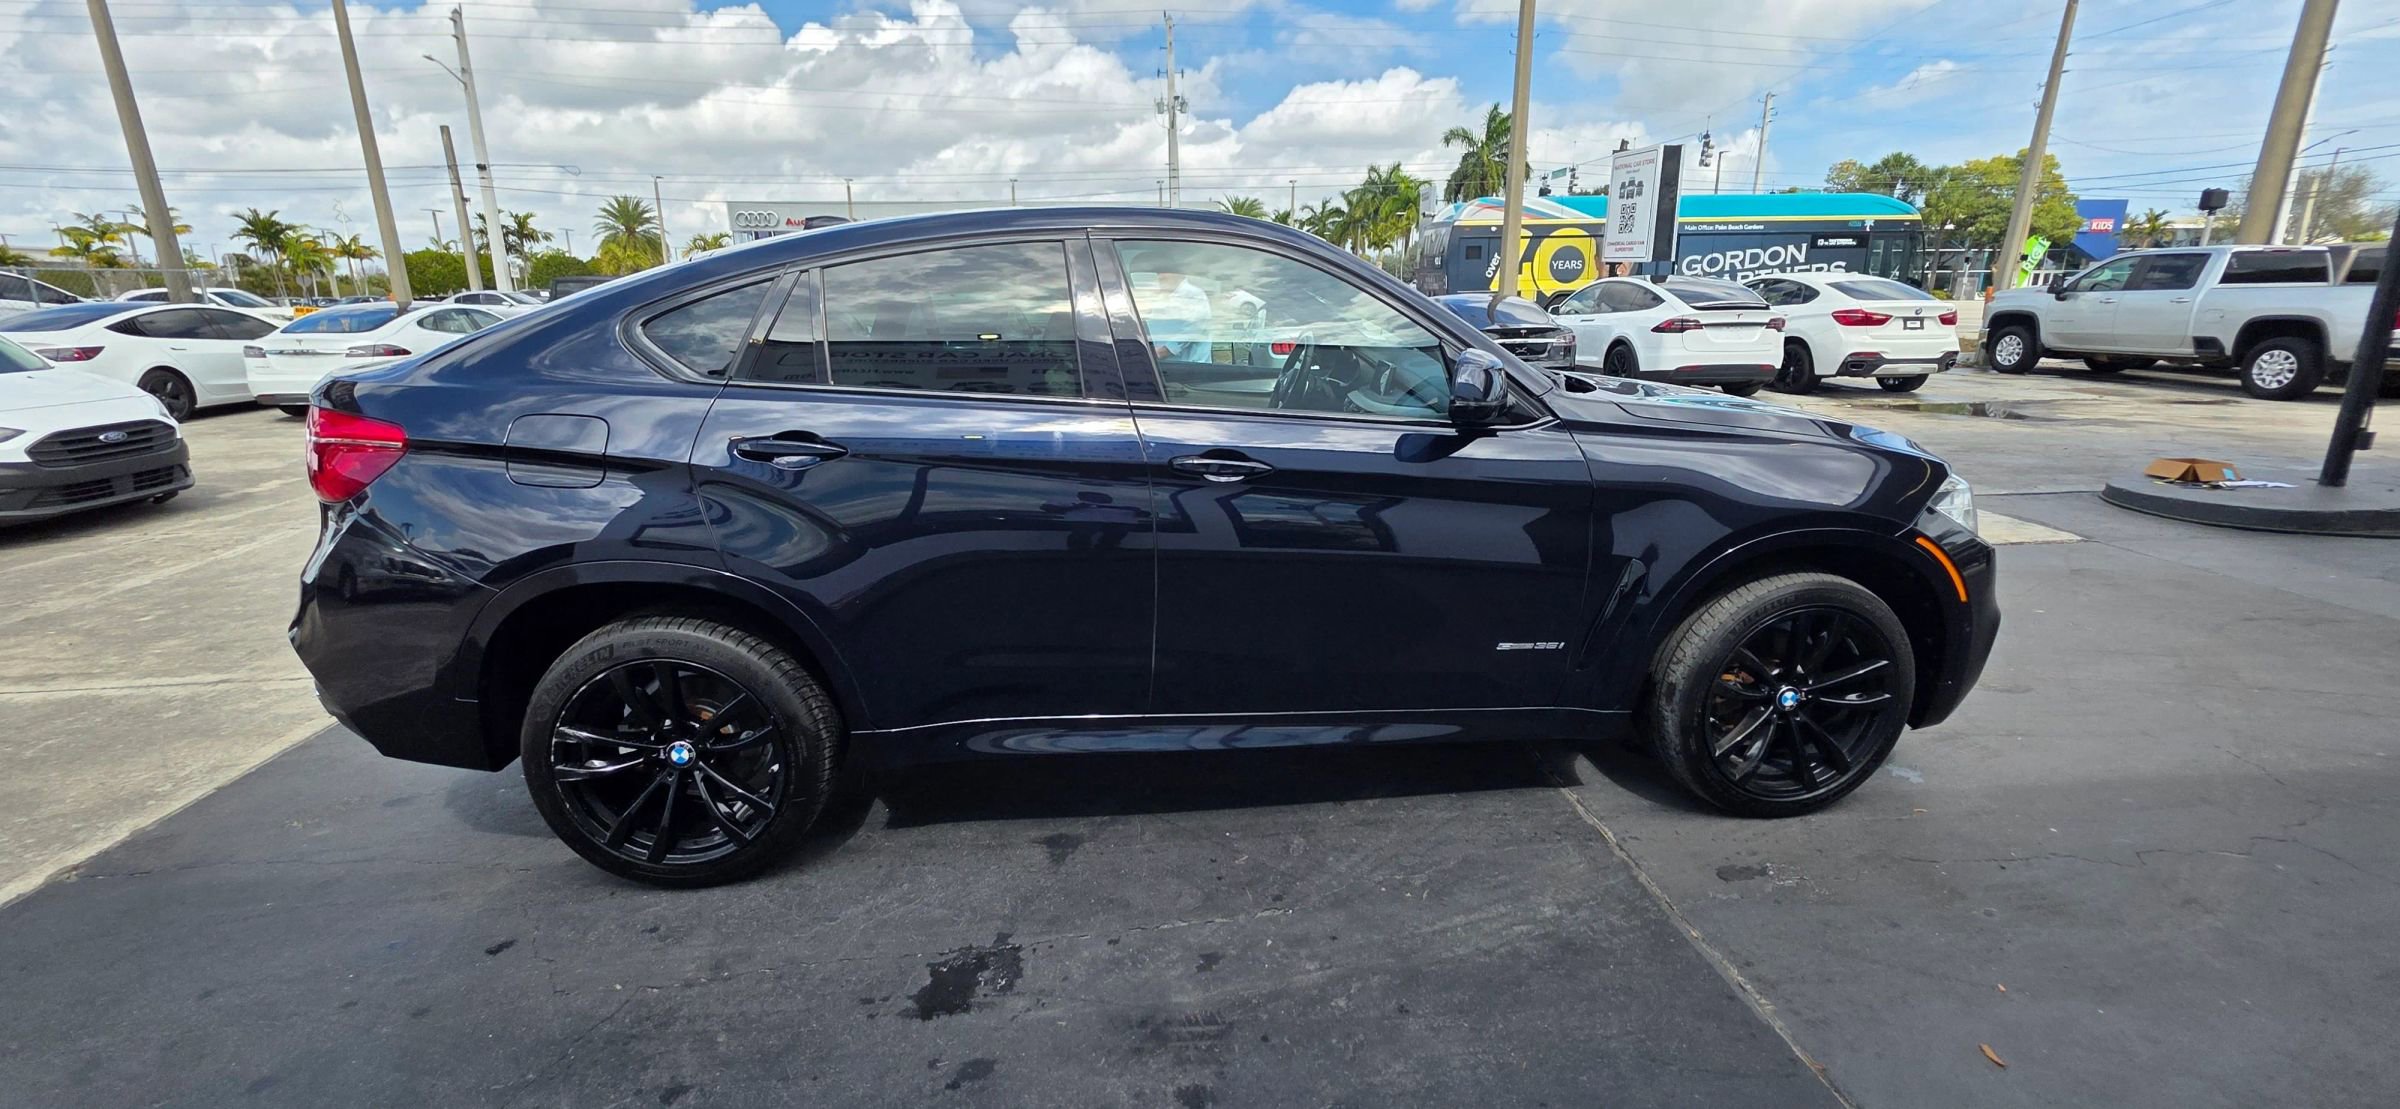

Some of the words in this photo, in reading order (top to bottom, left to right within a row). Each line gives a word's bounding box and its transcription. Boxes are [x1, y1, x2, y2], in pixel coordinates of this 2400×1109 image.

[2091, 220, 2113, 230] KIDS
[1682, 243, 1808, 276] GORDON
[1485, 252, 1501, 278] over
[1552, 260, 1583, 270] YEARS
[655, 639, 689, 648] SPORT
